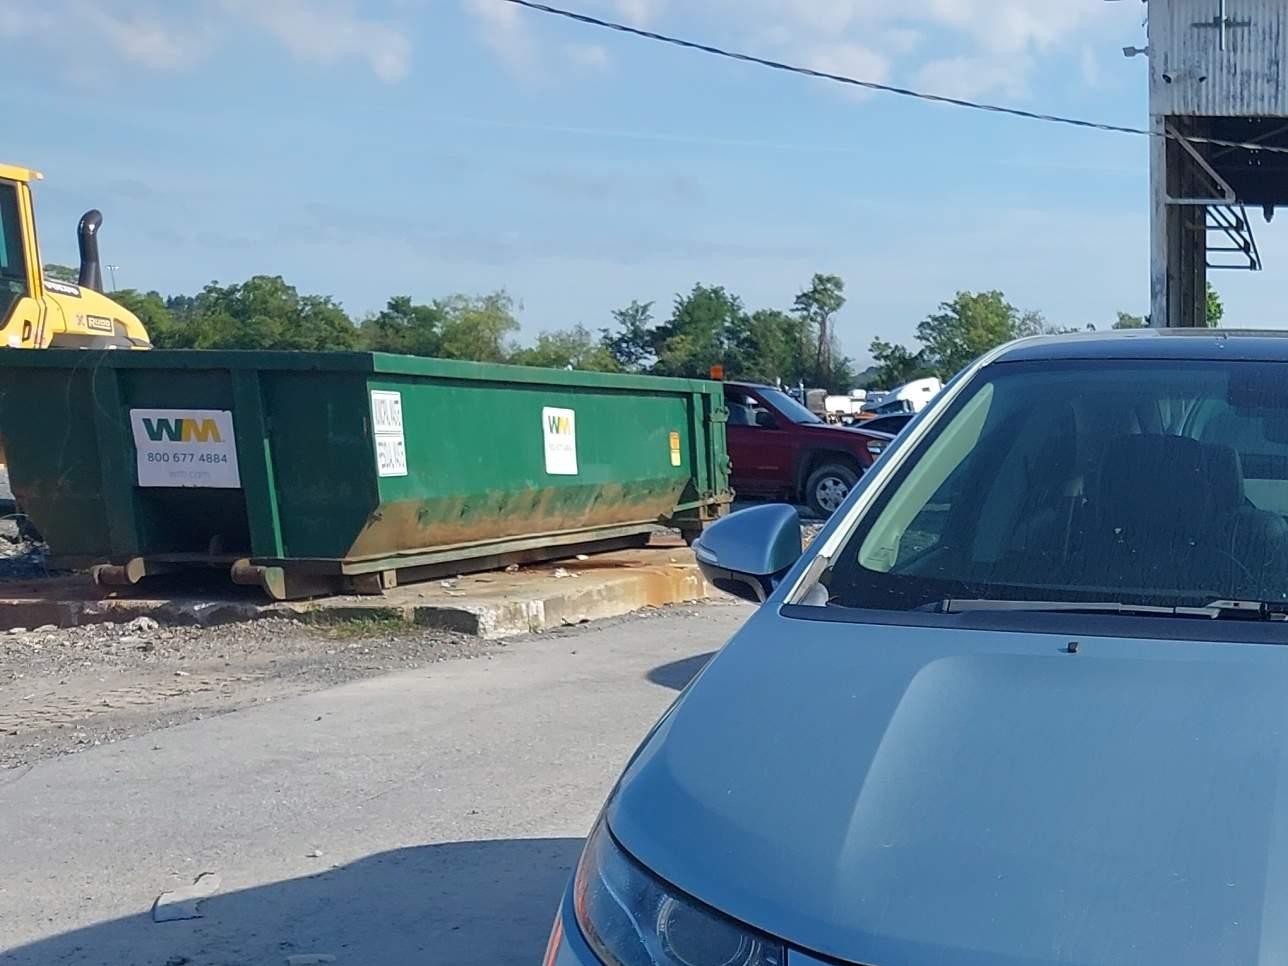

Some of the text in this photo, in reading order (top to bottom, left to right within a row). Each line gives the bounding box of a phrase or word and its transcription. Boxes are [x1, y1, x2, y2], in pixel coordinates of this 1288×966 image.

[142, 418, 223, 442] WM
[147, 452, 228, 464] 800 677 4884
